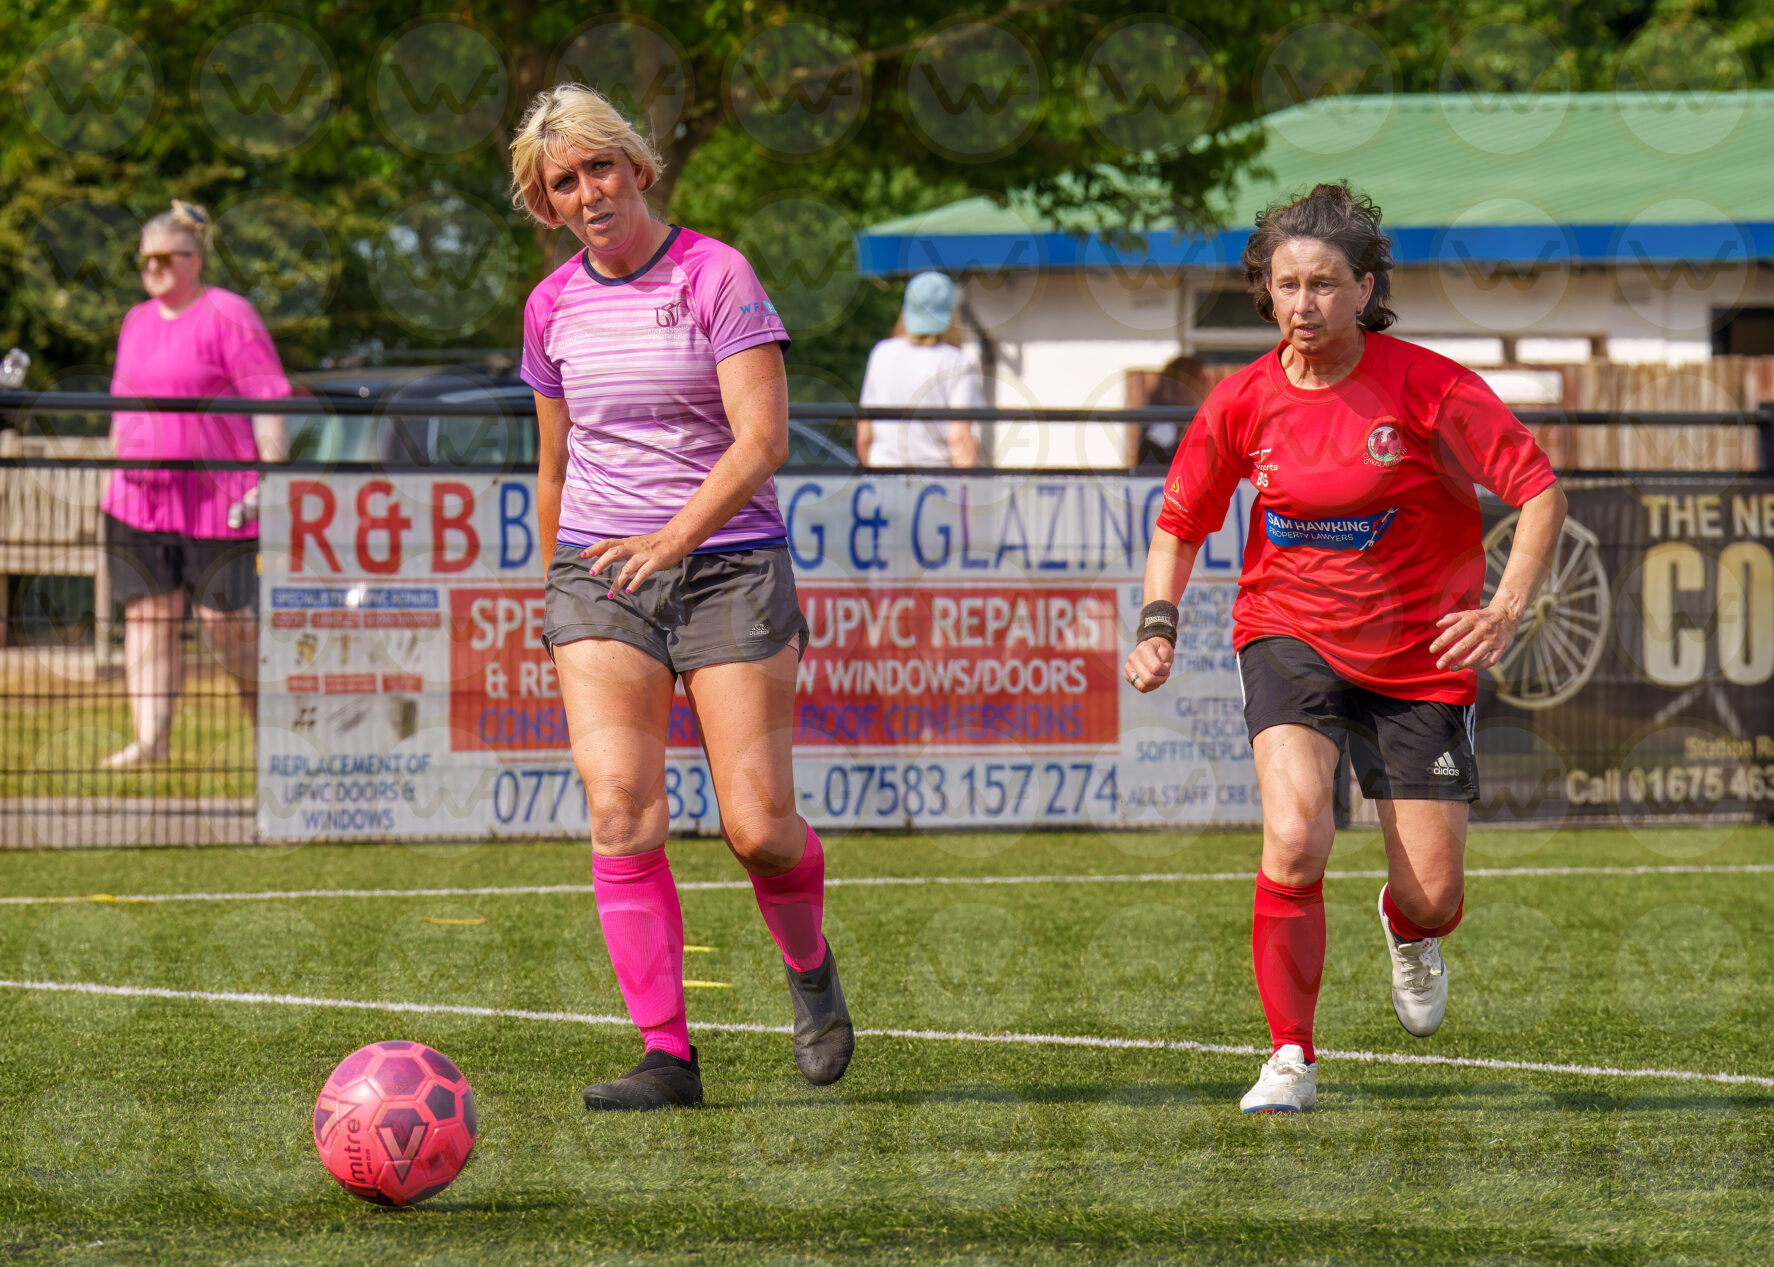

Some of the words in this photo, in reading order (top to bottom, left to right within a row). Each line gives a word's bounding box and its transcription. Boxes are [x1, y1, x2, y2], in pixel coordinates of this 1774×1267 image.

[288, 479, 481, 574] R&B
[848, 483, 889, 571] &
[1267, 512, 1293, 530] SAM
[1295, 520, 1370, 533] HAWKING
[1269, 526, 1309, 540] PROPERTY
[1311, 532, 1354, 542] LAWYERS
[1642, 495, 1723, 538] THE
[805, 597, 916, 649] UPVC
[931, 596, 1101, 649] REPAIRS
[485, 660, 510, 699] &
[824, 657, 1088, 696] WINDOWS/DOORS
[800, 703, 879, 739] ROOF
[883, 702, 1083, 740] CONVERSIONS
[269, 752, 402, 777] REPLACEMENT
[405, 753, 432, 775] OF
[1683, 735, 1753, 760] Station
[1433, 767, 1460, 777] didas
[1566, 770, 1621, 805] Call
[1628, 766, 1725, 804] 01675
[335, 780, 399, 803] DOORS
[493, 769, 588, 823] 0771
[664, 766, 708, 819] 83
[824, 763, 947, 818] 07583
[961, 762, 1035, 816] 157
[1043, 762, 1119, 816] 274
[302, 808, 396, 832] WINDOWS
[344, 1119, 366, 1182] mitre
